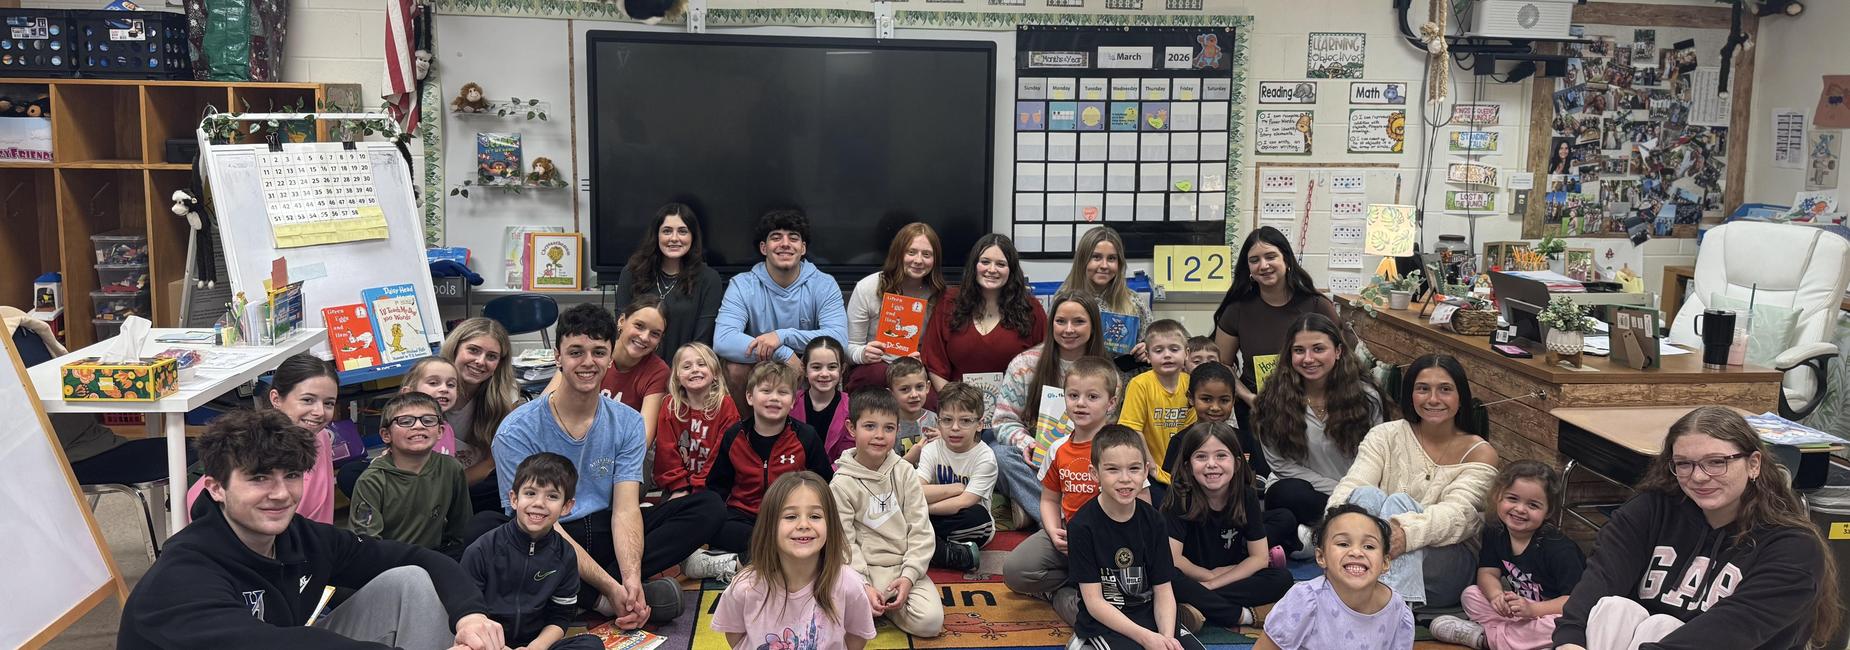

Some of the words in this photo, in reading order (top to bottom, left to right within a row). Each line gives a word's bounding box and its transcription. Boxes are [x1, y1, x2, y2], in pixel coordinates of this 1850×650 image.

[1313, 36, 1360, 51] LEARNING
[1066, 54, 1082, 64] Year
[1116, 53, 1141, 61] March
[1168, 53, 1190, 62] 2026
[1262, 86, 1293, 100] Reading
[1356, 86, 1380, 99] Math
[891, 303, 904, 311] Eggs
[895, 342, 909, 352] Seuss
[1064, 480, 1094, 493] Shots
[1637, 545, 1743, 612] GAP
